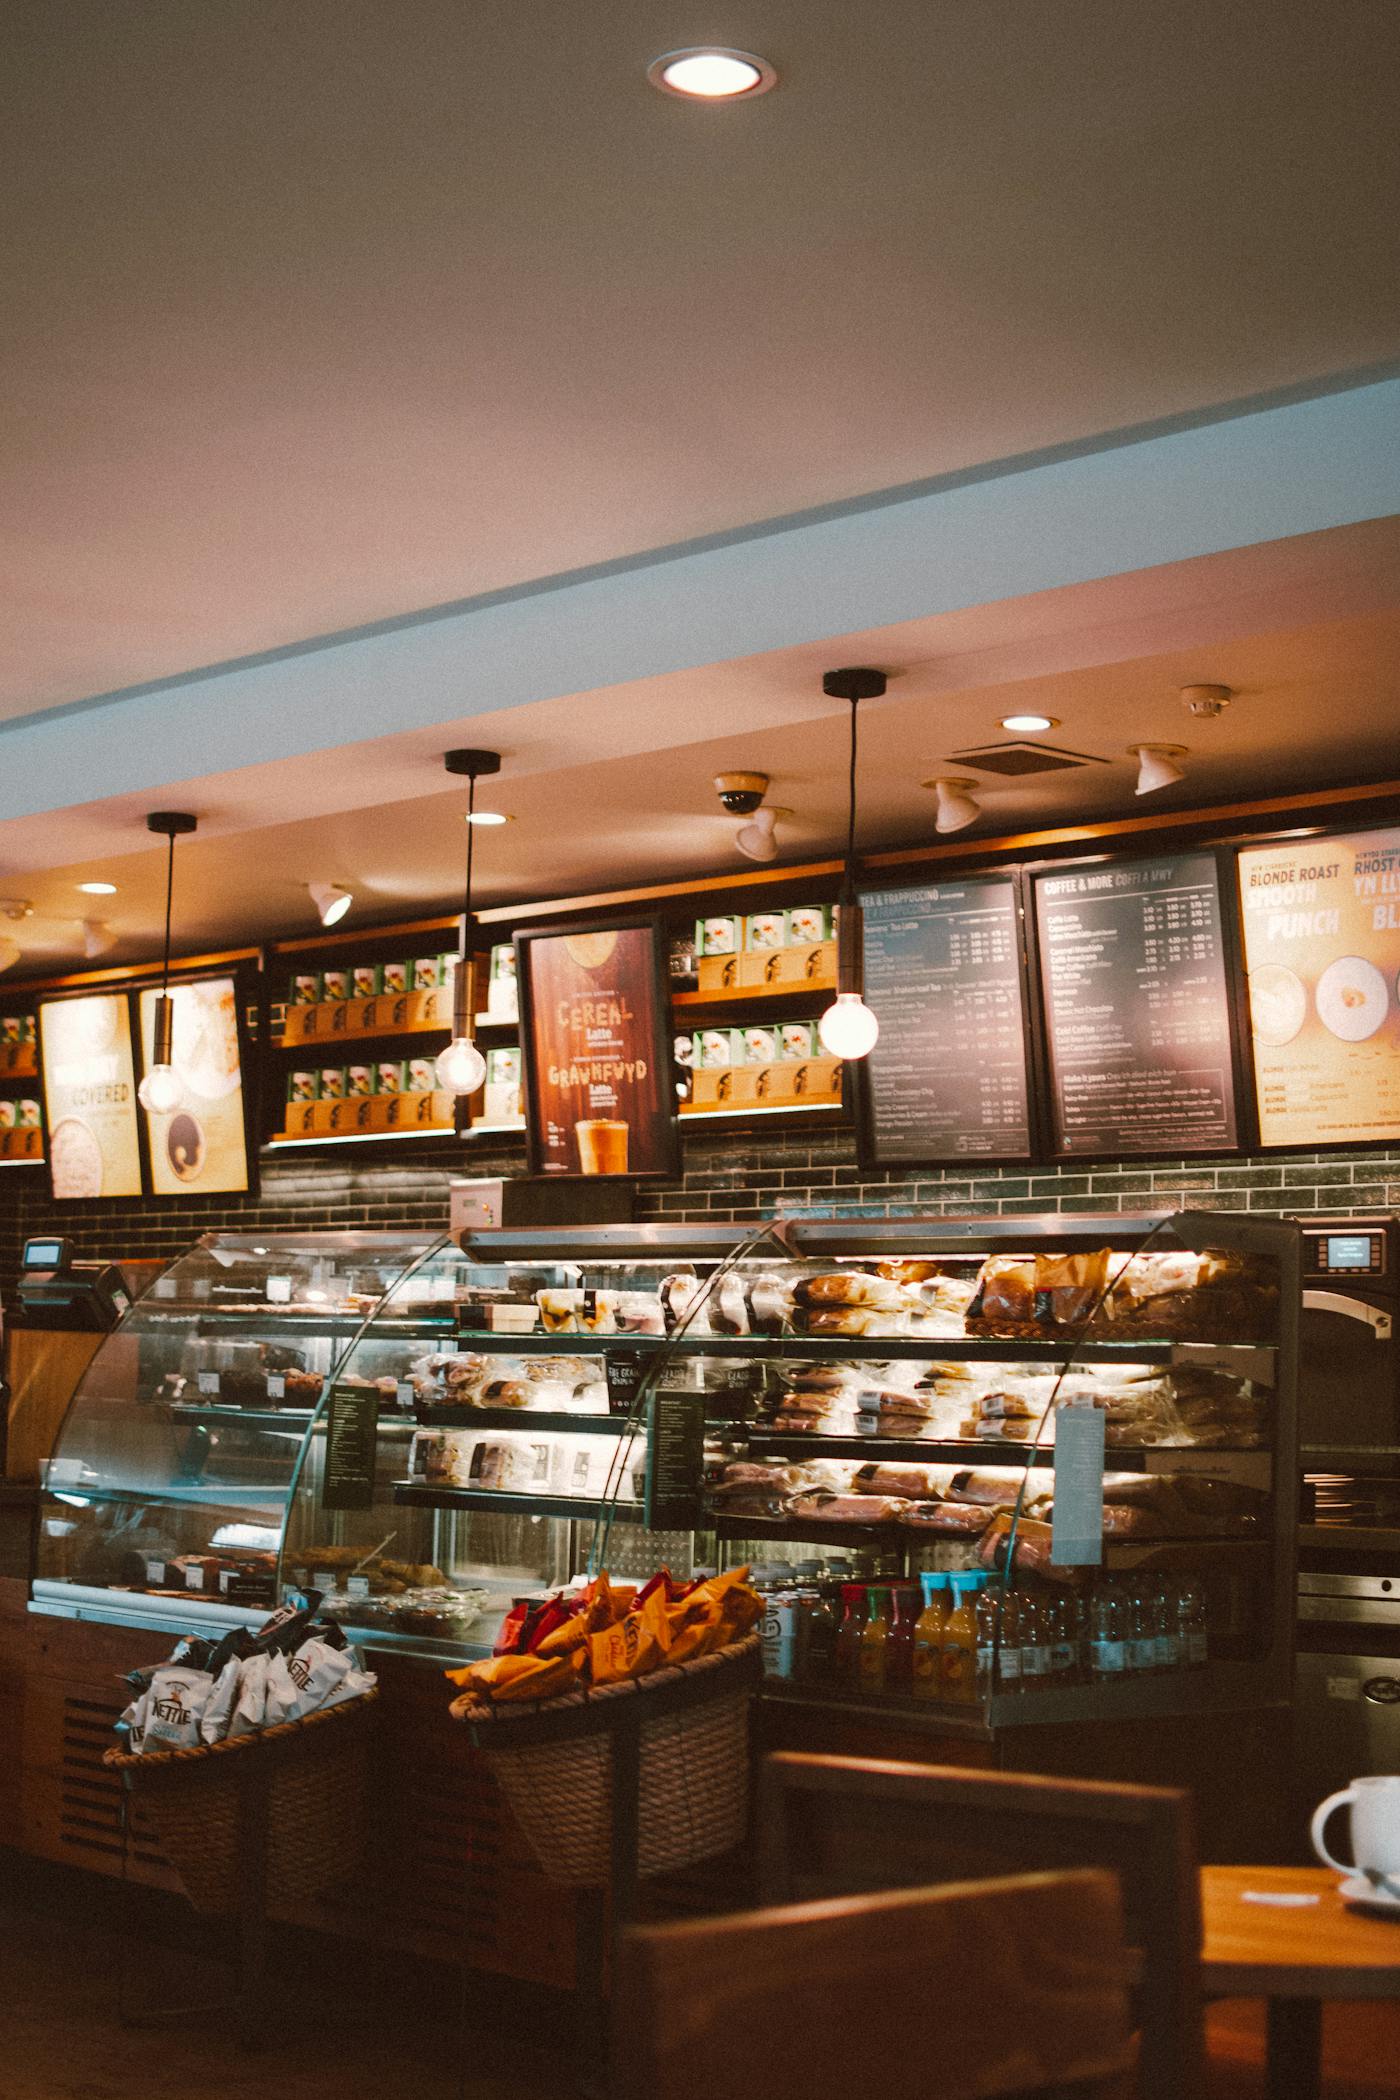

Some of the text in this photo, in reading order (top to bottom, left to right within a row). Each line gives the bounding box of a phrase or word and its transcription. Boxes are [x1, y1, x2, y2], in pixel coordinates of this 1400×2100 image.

[1250, 864, 1340, 887] BLONDE ROAST
[1354, 857, 1394, 875] RHOST
[884, 888, 939, 906] FRAPPUCCINO
[1044, 879, 1077, 896] COFFEE
[1078, 878, 1087, 893] &
[1088, 875, 1113, 890] MORE
[1267, 908, 1340, 940] PUNCH
[1372, 903, 1400, 931] BL
[557, 997, 634, 1031] CEREAL
